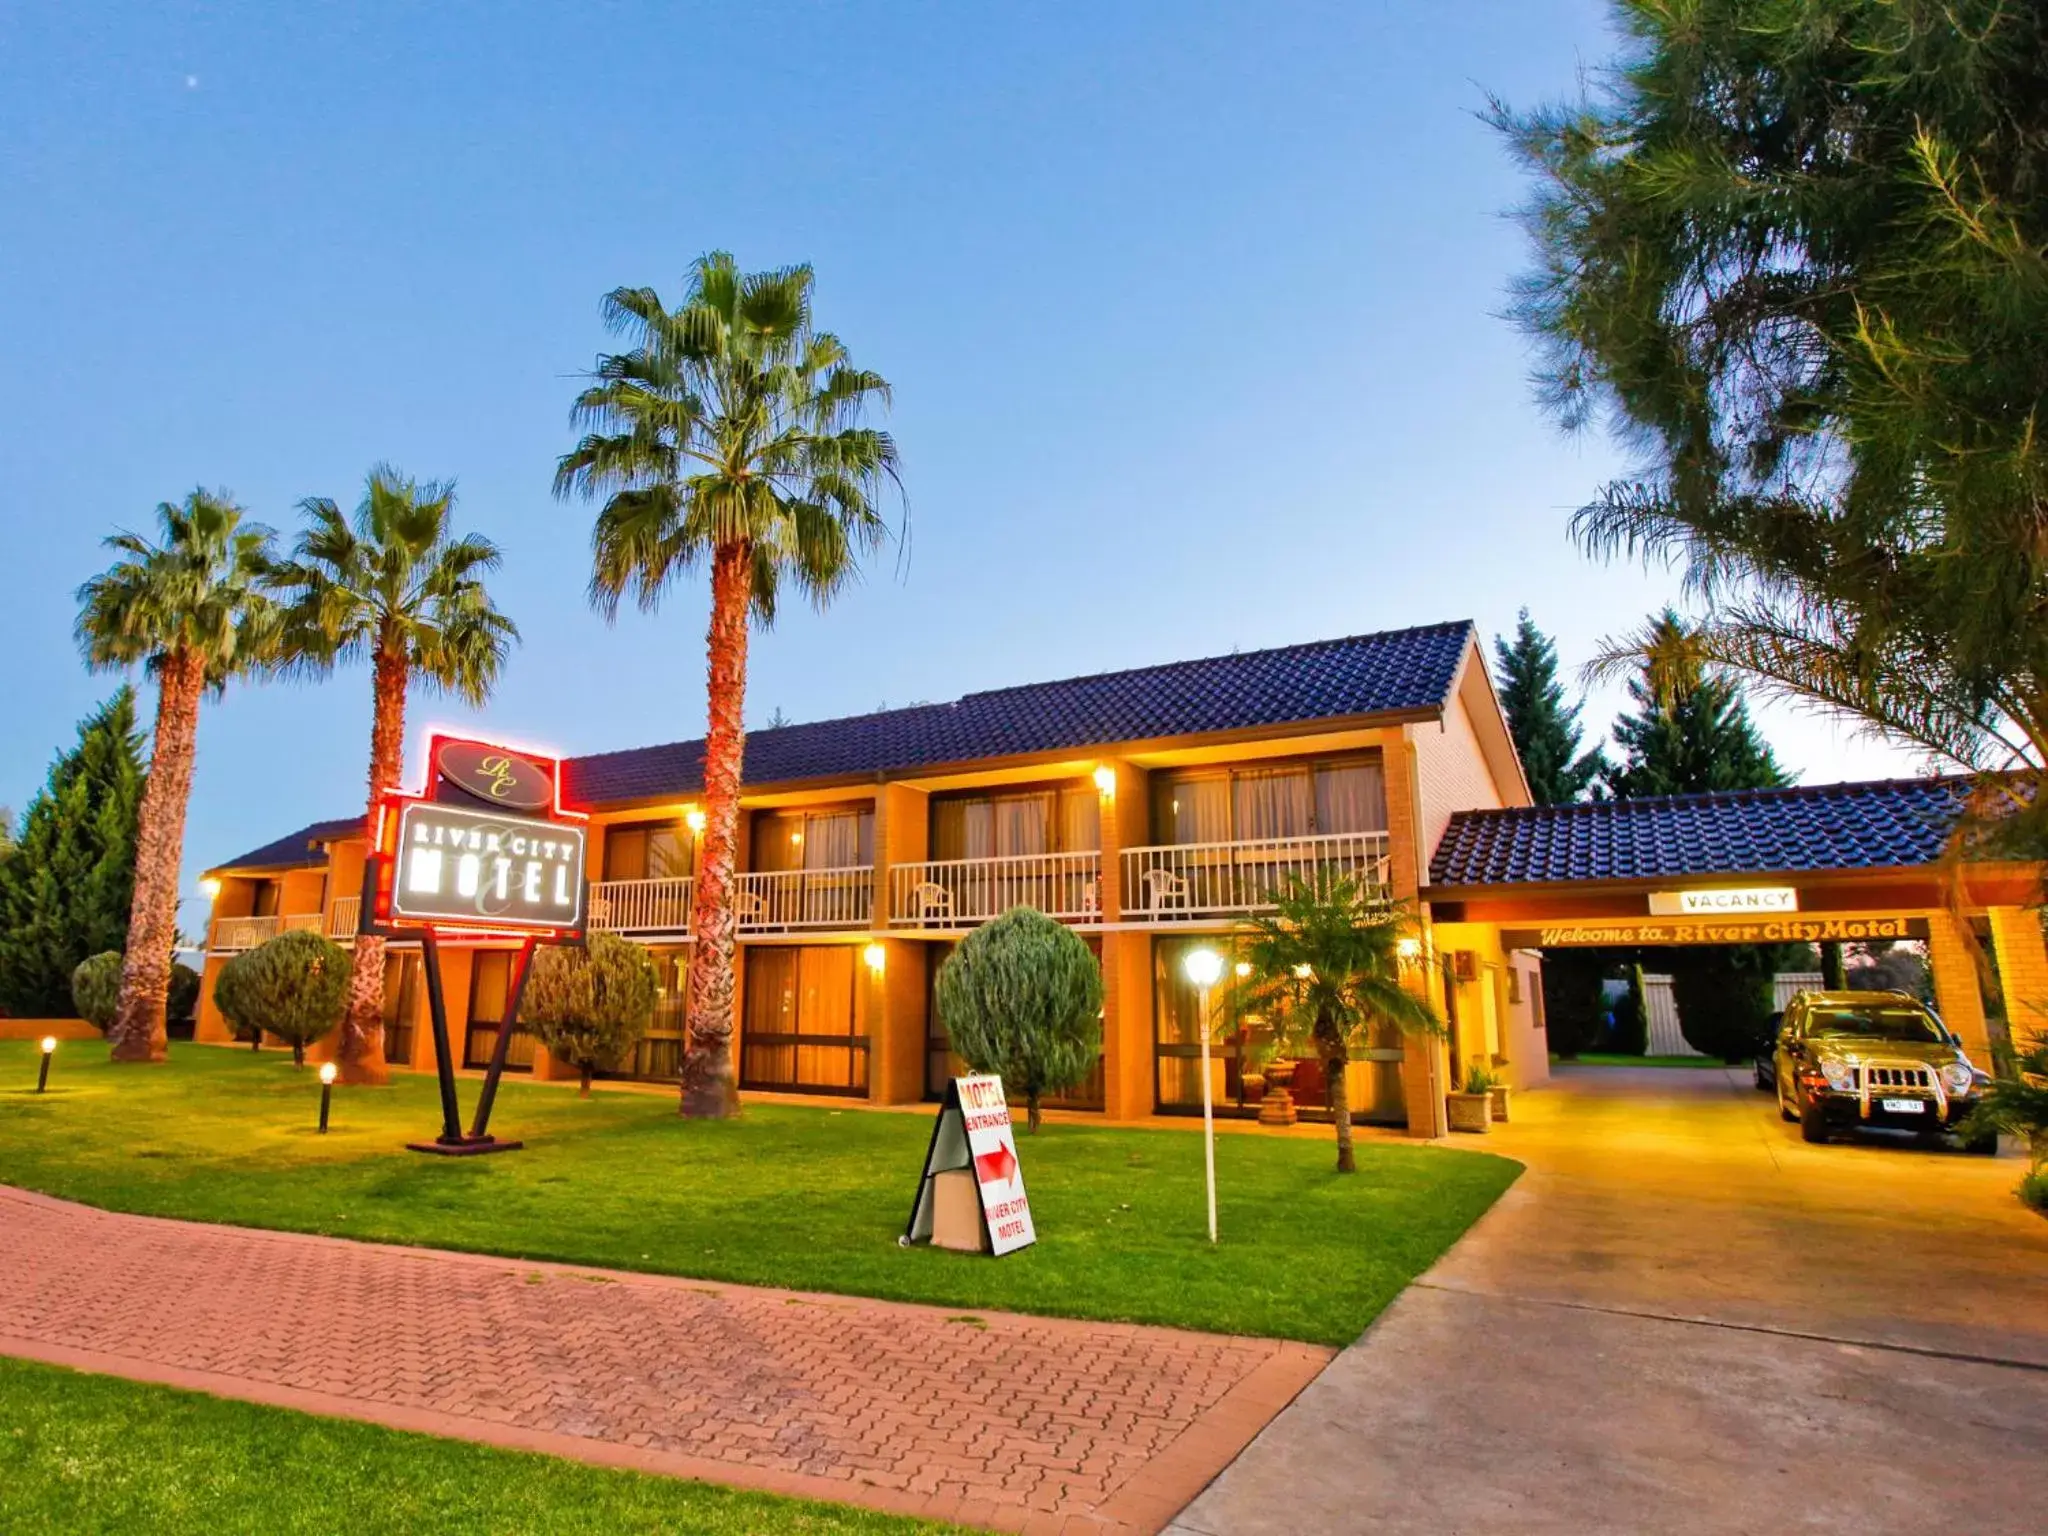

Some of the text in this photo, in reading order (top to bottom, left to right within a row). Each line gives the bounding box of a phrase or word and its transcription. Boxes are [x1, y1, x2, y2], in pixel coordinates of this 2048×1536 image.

[414, 822, 574, 861] RIVER CITY
[408, 847, 571, 905] MOTEL
[1687, 891, 1791, 908] VACANCY
[1541, 926, 1634, 945] Welcome
[1674, 923, 1760, 941] River
[1763, 921, 1820, 941] City
[1822, 919, 1908, 939] Motel
[960, 1082, 1004, 1110] MOTEL
[965, 1112, 1012, 1132] ENTRANCE
[985, 1198, 1028, 1222] RIVER CITY
[998, 1220, 1025, 1241] MOTEL
